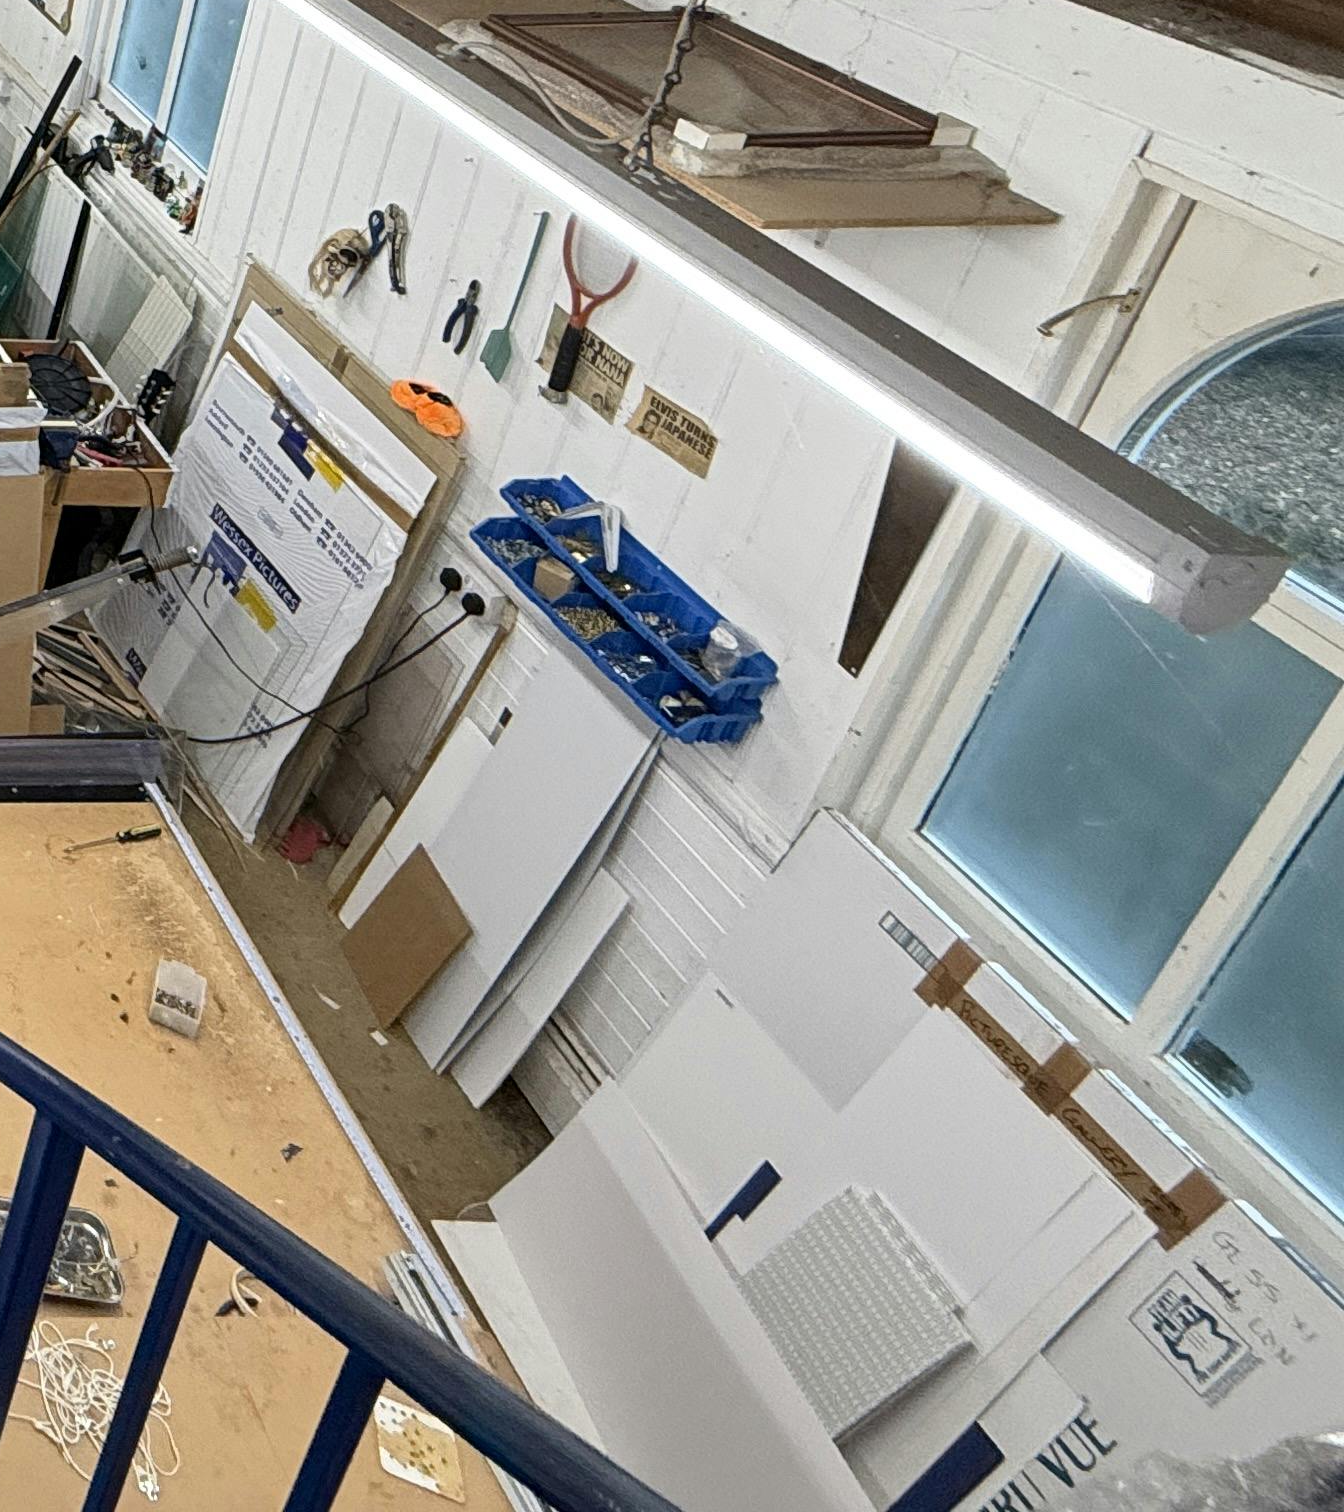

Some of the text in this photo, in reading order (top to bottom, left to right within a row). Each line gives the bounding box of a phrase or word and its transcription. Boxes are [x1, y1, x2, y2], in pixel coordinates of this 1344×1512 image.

[580, 342, 595, 362] OR
[602, 343, 630, 373] NOW
[650, 396, 718, 448] ELVIS TURNS
[661, 418, 713, 460] JAPANESE
[214, 506, 253, 556] Wessex
[252, 551, 298, 610] Pictures
[1034, 1395, 1118, 1488] VUE
